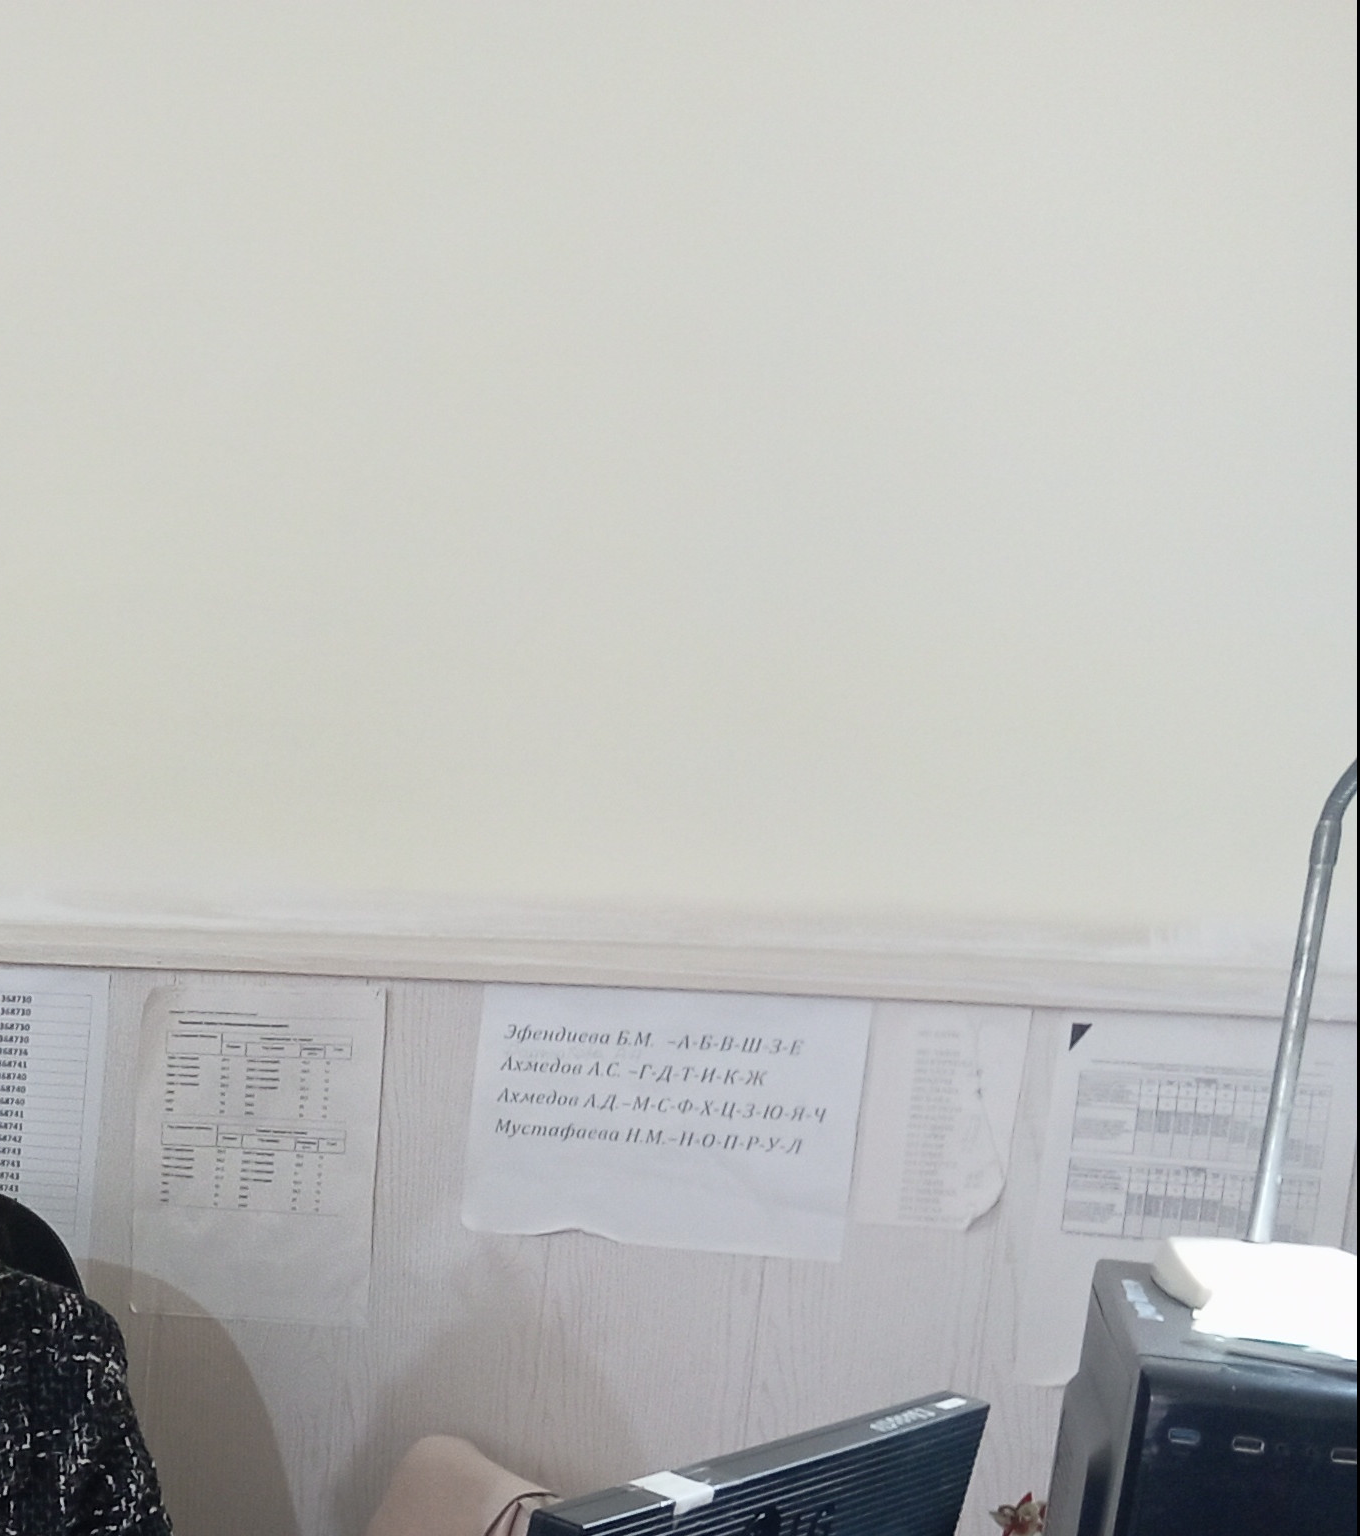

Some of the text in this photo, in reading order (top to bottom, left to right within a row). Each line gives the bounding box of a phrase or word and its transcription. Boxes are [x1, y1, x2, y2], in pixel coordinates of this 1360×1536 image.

[503, 1024, 611, 1046] Эфендиева
[616, 1029, 654, 1048] Б.М.
[500, 1055, 583, 1076] Ахмедов
[587, 1061, 621, 1077] А.С.
[497, 1087, 579, 1106] Ахмедов
[495, 1118, 620, 1142] Мустафаева
